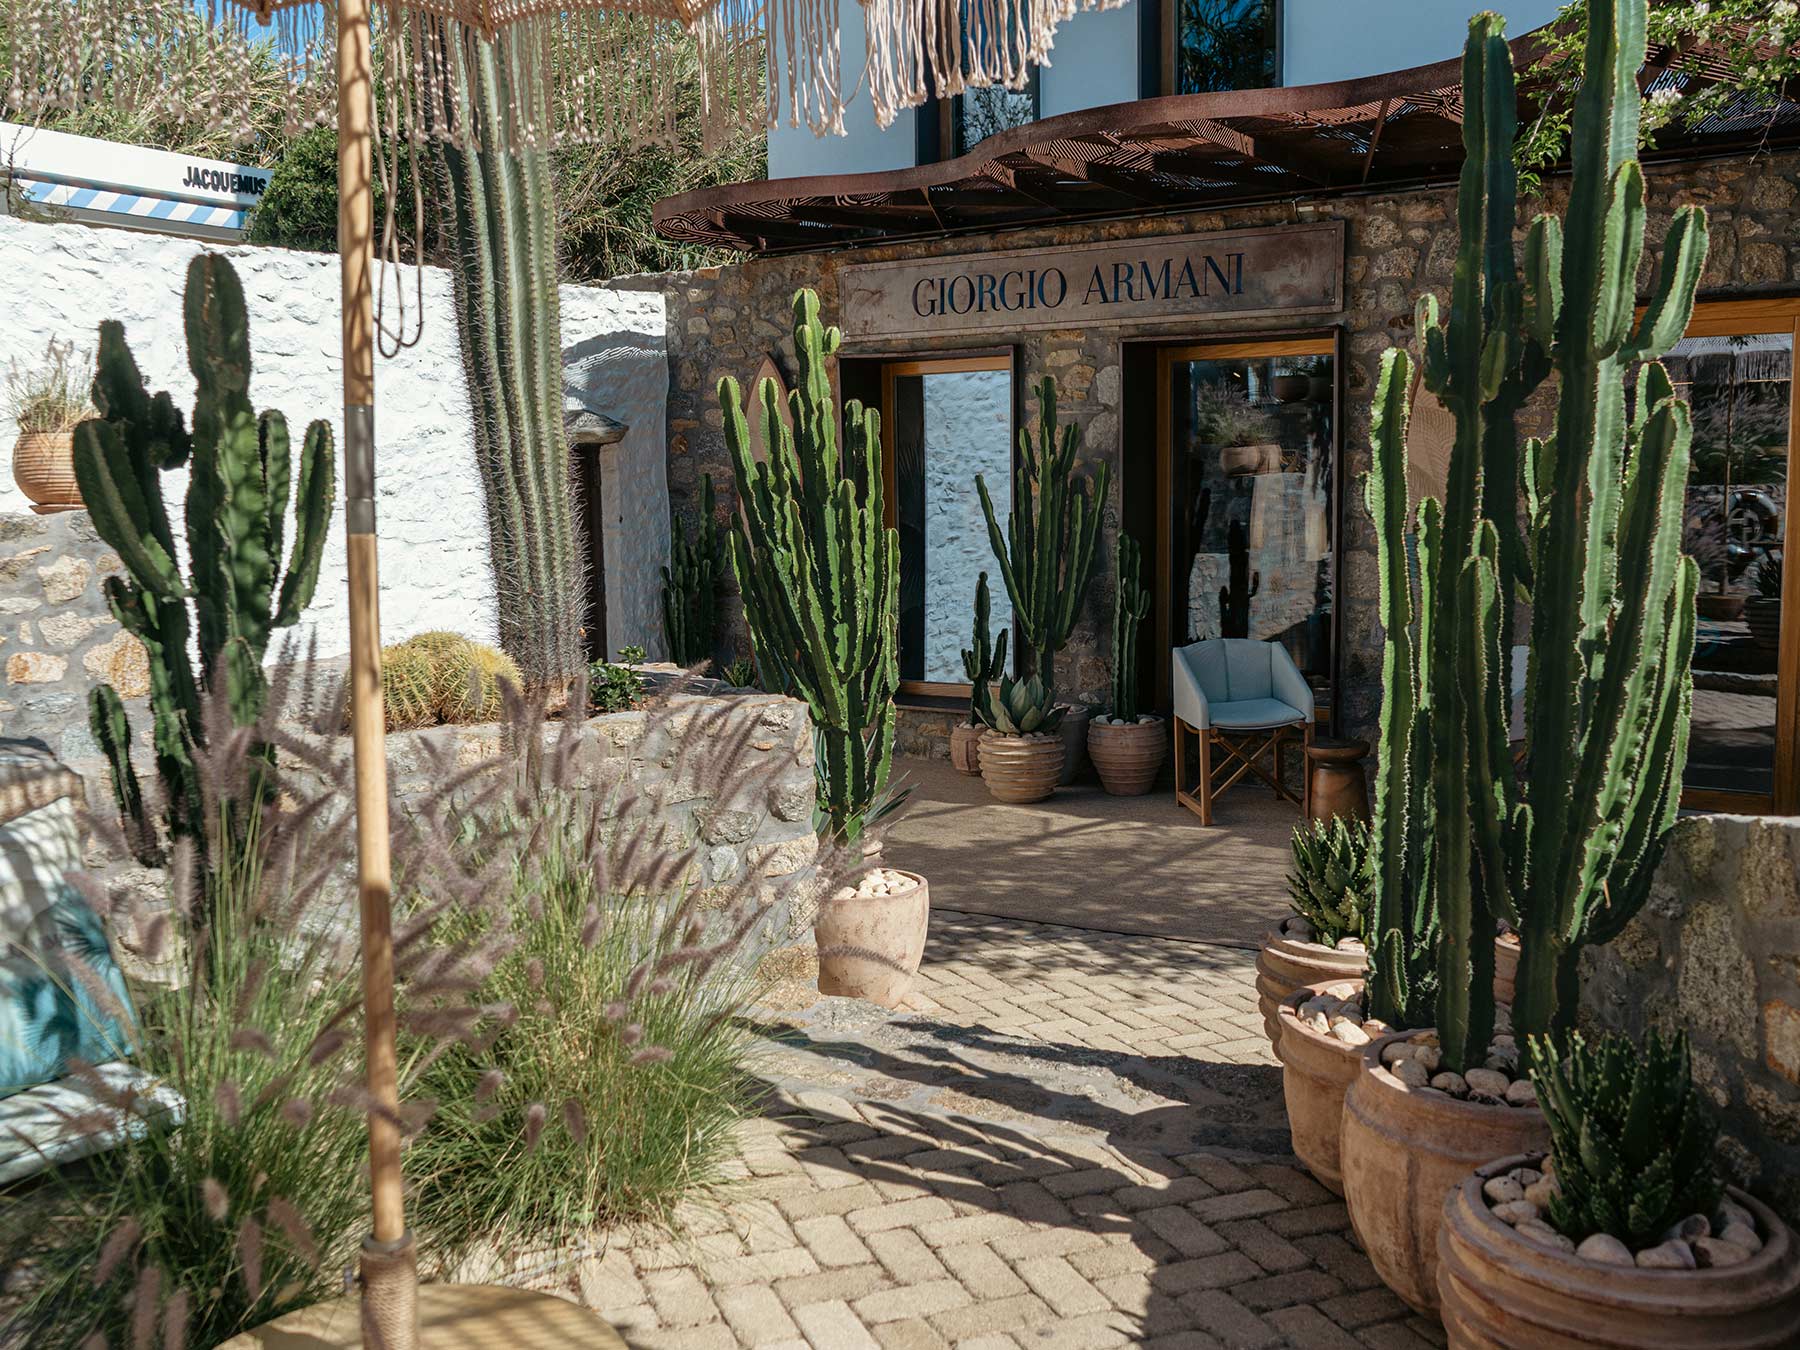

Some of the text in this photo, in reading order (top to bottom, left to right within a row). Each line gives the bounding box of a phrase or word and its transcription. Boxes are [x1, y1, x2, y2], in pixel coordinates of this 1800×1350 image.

[182, 166, 267, 196] JACQUEMUS
[911, 252, 1245, 317] GIORGIO ARMANI
